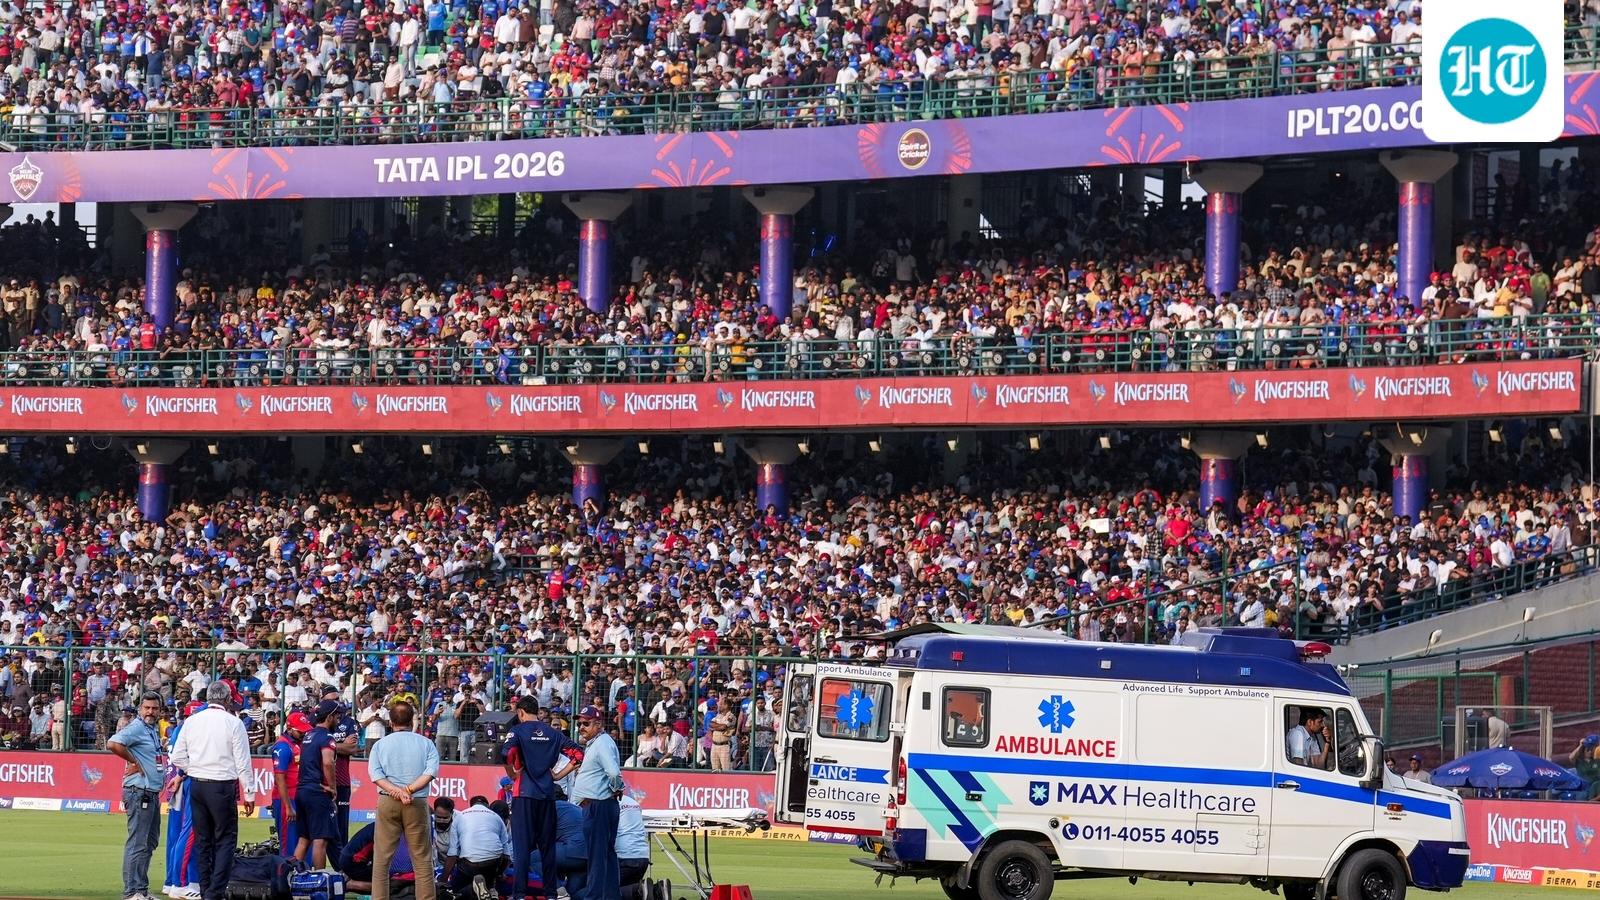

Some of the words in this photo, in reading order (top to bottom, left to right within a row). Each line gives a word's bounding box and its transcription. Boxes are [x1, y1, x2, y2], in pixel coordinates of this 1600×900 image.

[900, 143, 919, 152] Spirit
[900, 150, 928, 158] Cricket
[374, 156, 440, 183] TATA
[447, 155, 488, 181] IPL
[493, 151, 565, 178] 2026
[1114, 382, 1190, 404] KINGFISHER
[1254, 379, 1329, 403] KINGFISHER
[1374, 376, 1452, 400] KINGFISHER
[1497, 371, 1575, 395] KINGFISHER
[11, 395, 83, 416] KINGFISHER
[146, 395, 218, 416] KINGFISHER
[260, 395, 332, 416] KINGFISHER
[376, 394, 448, 414] KINGFISHER
[510, 394, 582, 415] KINGFISHER
[624, 392, 698, 413] KINGFISHER
[741, 388, 816, 410] KINGFISHER
[879, 386, 952, 408] KINGFISHER
[996, 384, 1069, 408] KINGFISHER
[818, 665, 842, 674] pport
[844, 667, 892, 678] Ambulance
[1123, 683, 1165, 692] Advanced
[1168, 686, 1183, 694] Life
[1188, 686, 1221, 697] Support
[1224, 688, 1269, 698] Ambulance
[995, 735, 1116, 758] AMBULANCE
[669, 783, 749, 809] KINGFISHER
[808, 786, 880, 803] ealthcare
[1057, 783, 1117, 806] MAX
[1124, 786, 1256, 813] Healthcare
[73, 800, 105, 811] AngelOne
[806, 808, 821, 819] 55
[825, 809, 856, 821] 4055
[711, 830, 749, 838] SIERRA
[762, 831, 801, 839] SIERRA
[810, 830, 828, 841] RuPay
[833, 832, 854, 843] RuPay
[1082, 825, 1165, 843] 011-4055
[1171, 827, 1219, 846] 4055
[1487, 813, 1569, 848] KINGFISHER
[1503, 867, 1532, 881] KINGFISHER
[1546, 877, 1577, 887] SIERRA
